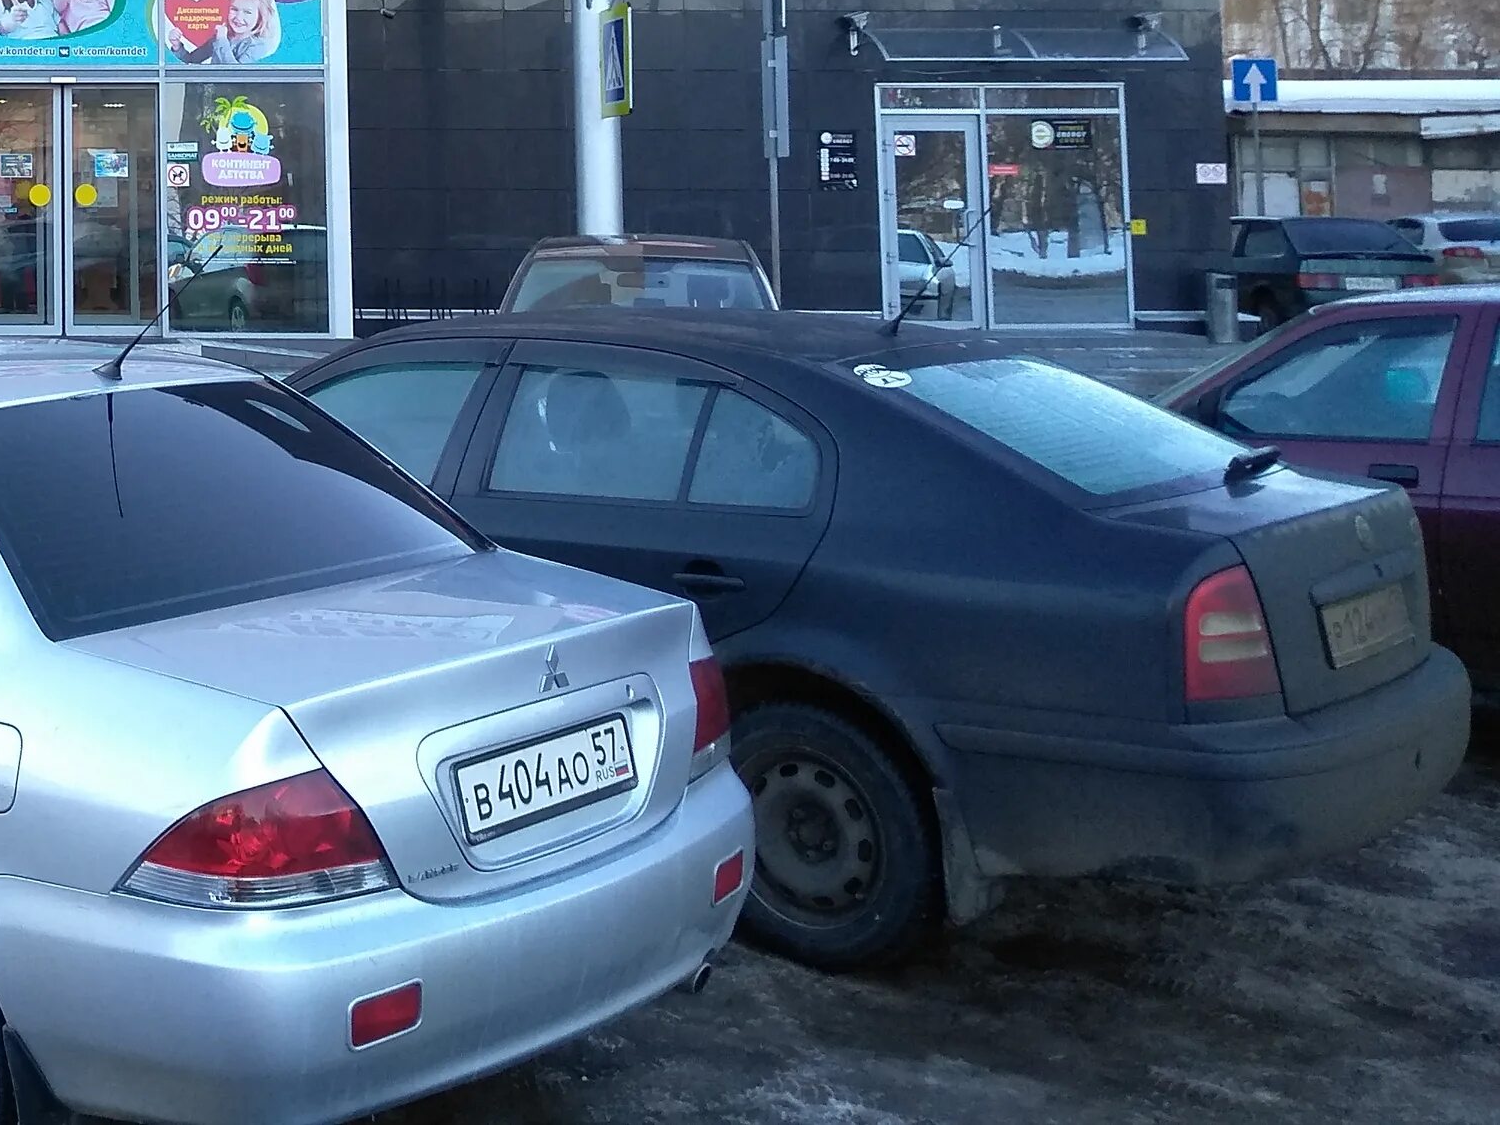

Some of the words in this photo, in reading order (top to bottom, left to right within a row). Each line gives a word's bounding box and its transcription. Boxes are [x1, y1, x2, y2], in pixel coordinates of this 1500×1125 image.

[73, 46, 147, 56] vk.com/kontdet
[211, 158, 271, 169] КОНТИНЕНТ
[218, 169, 264, 180] ДЕТСТВА
[201, 195, 238, 205] режим
[241, 194, 283, 206] работы:
[265, 244, 293, 255] дней
[474, 750, 590, 821] В404АО
[591, 727, 616, 766] 57
[596, 767, 616, 782] RUS
